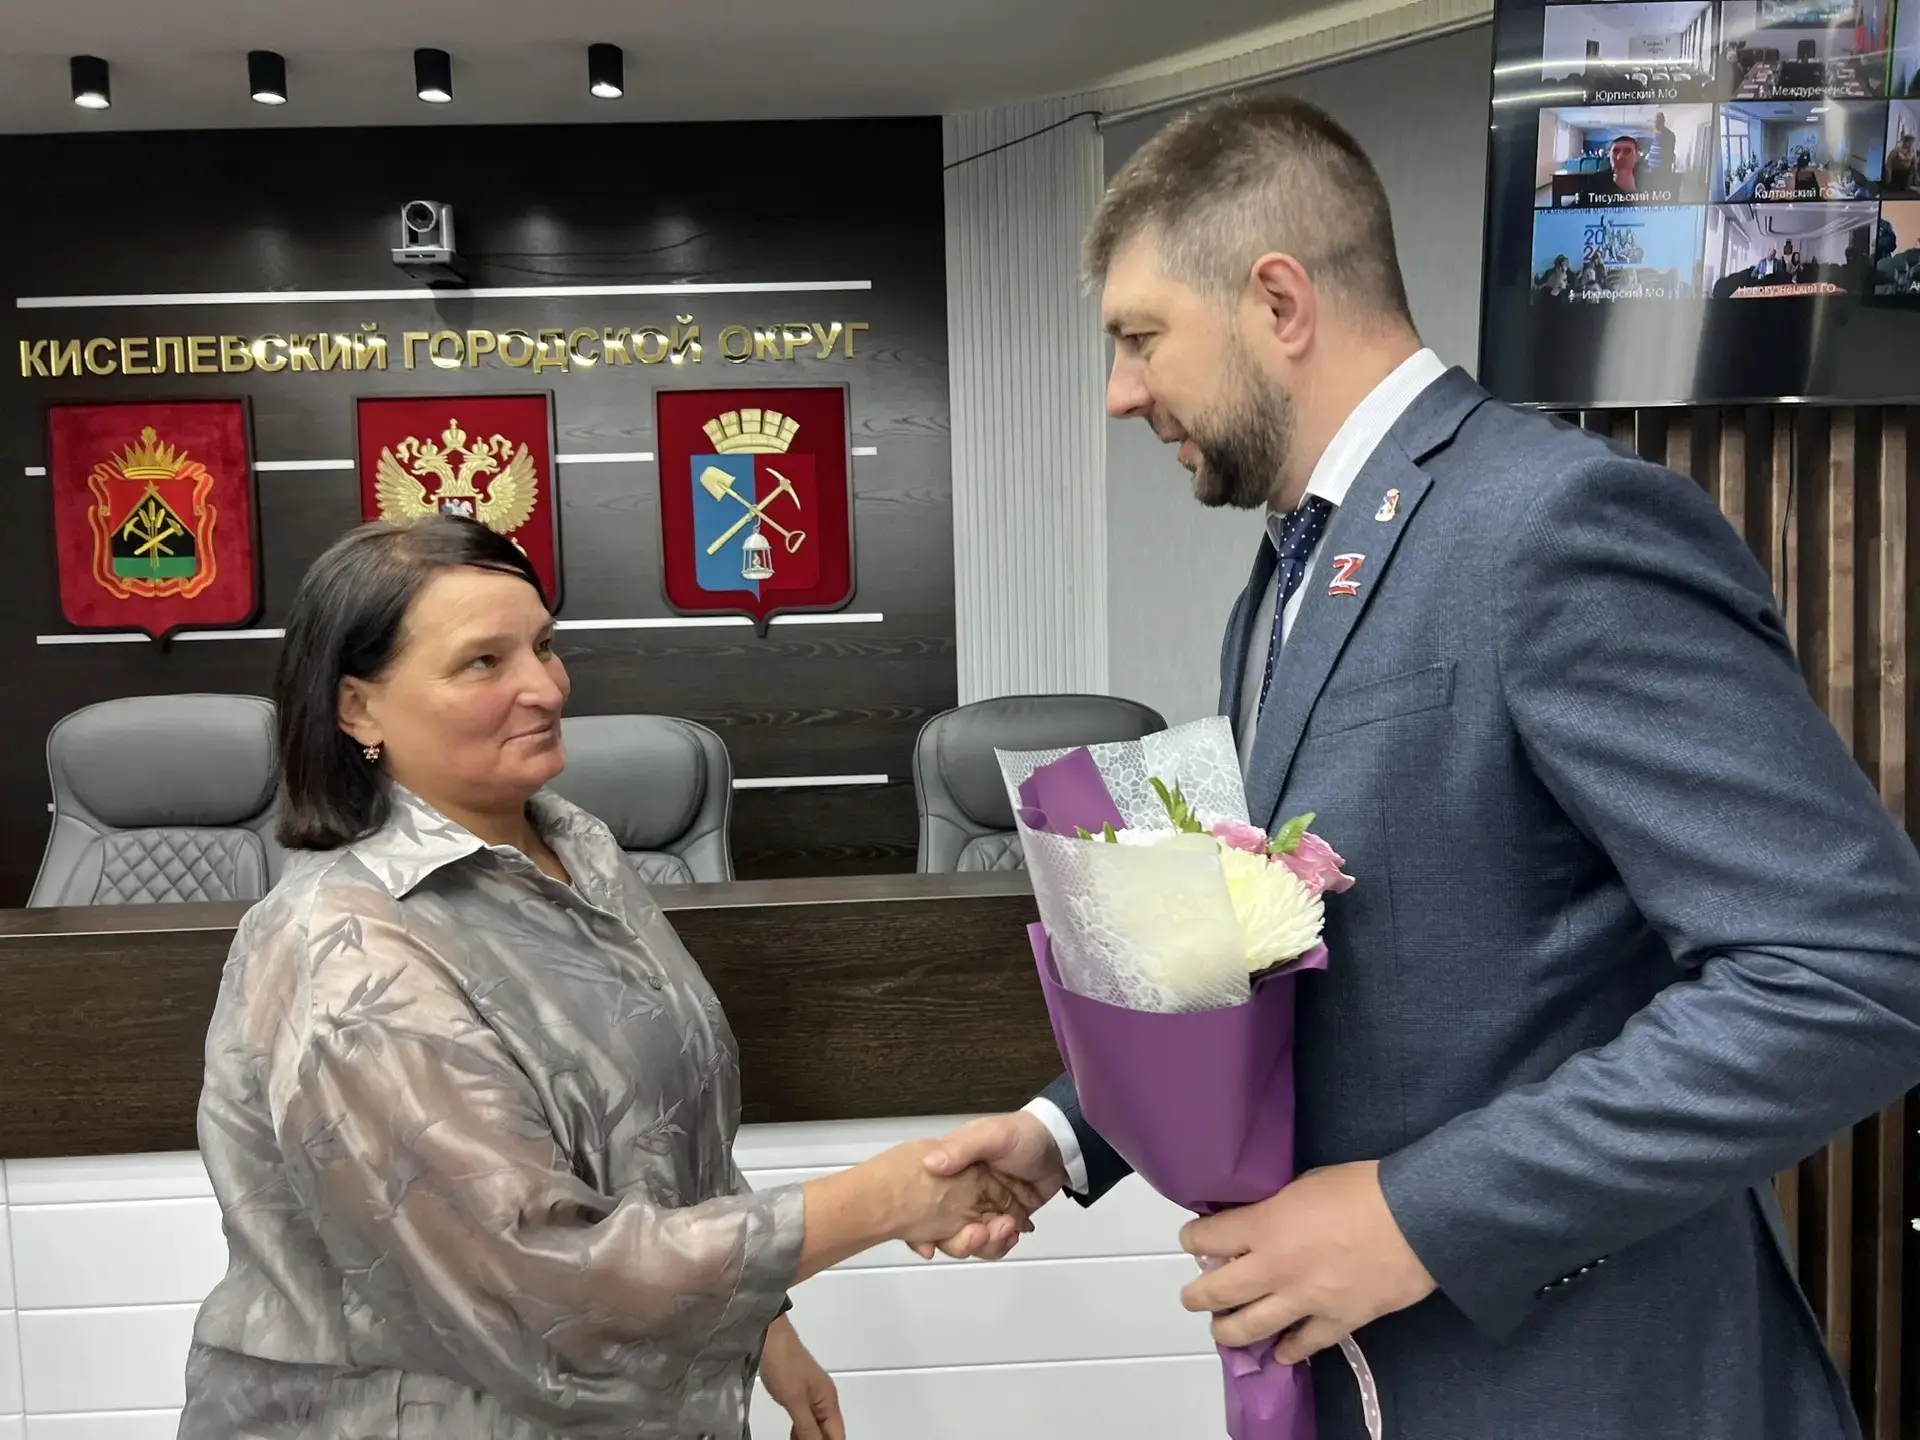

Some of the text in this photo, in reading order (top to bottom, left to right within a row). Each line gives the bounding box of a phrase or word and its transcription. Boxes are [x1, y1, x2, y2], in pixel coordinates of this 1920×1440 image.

[1595, 88, 1678, 103] Юргинский МО
[1588, 190, 1672, 204] Тисульский МО
[1754, 183, 1817, 199] Калтанский
[20, 313, 869, 377] КИСЕЛЕВСКИЙ ГОРОДСКОЙ ОКРУГ
